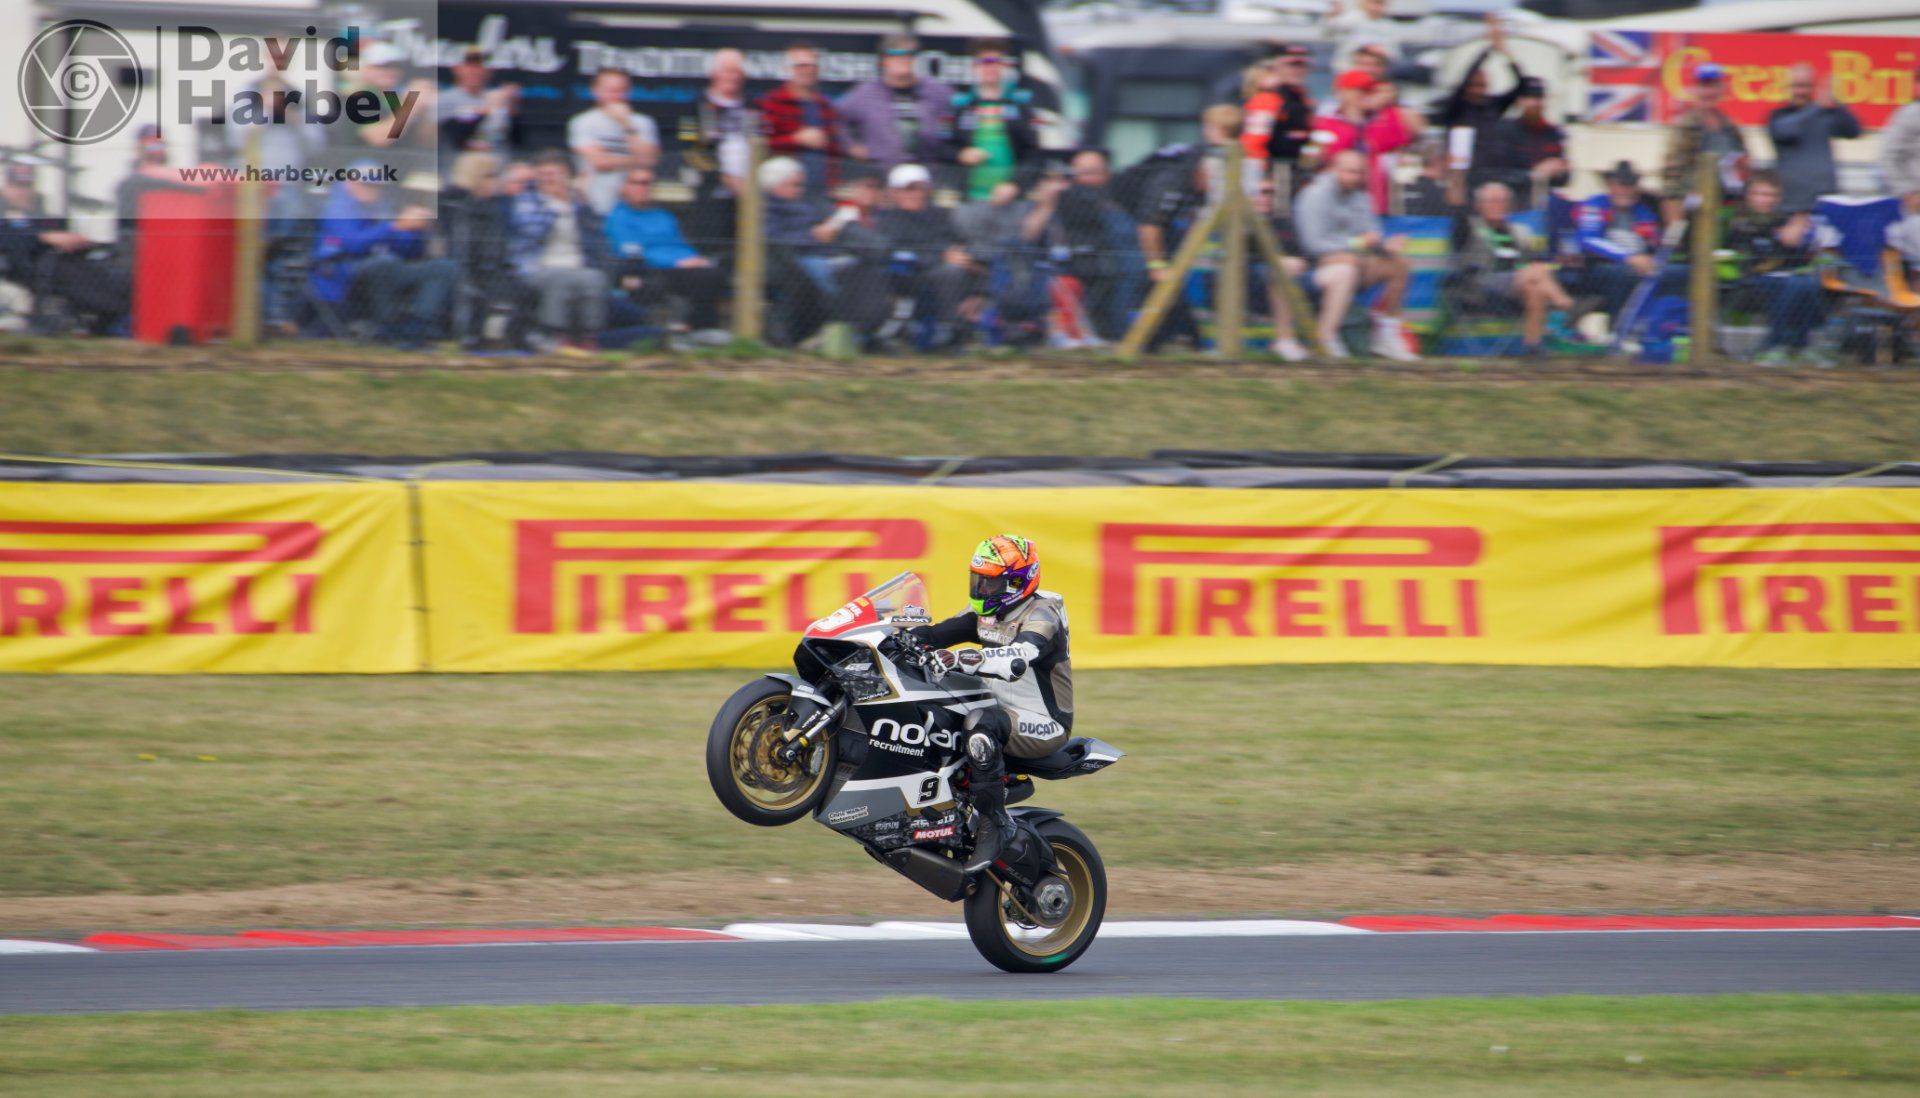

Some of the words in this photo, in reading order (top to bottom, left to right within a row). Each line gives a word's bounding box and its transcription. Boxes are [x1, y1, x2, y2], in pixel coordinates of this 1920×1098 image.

[0, 520, 324, 637] RELLI
[1098, 522, 1484, 637] PIRELLI
[984, 645, 1027, 658] UCATI
[1019, 721, 1060, 736] DUCATI
[868, 737, 925, 757] recruitment
[917, 774, 942, 805] 9
[914, 828, 954, 840] MOTUL
